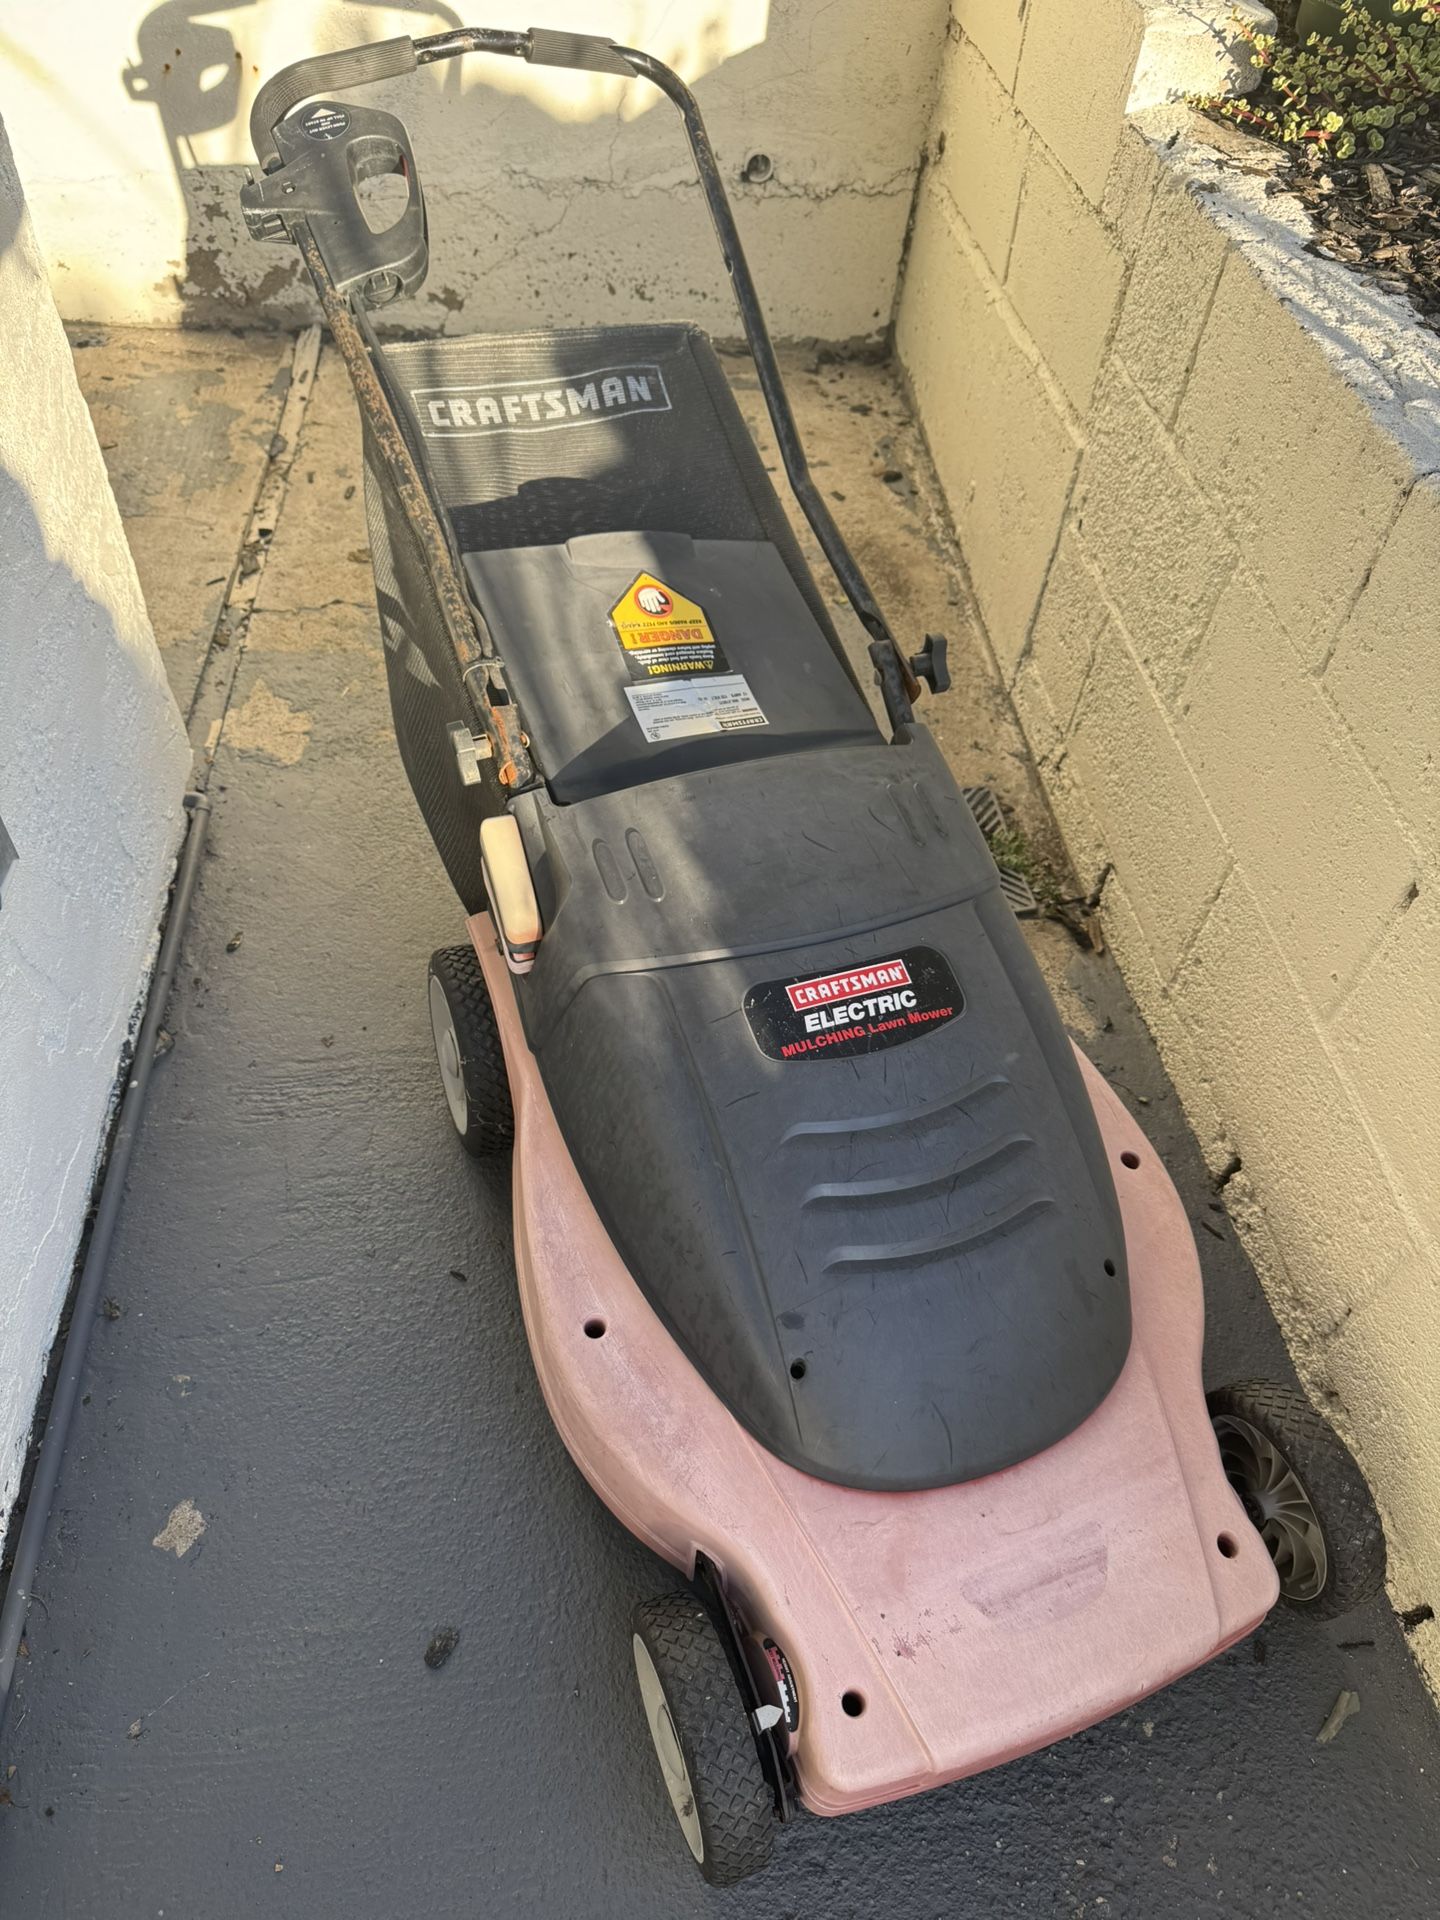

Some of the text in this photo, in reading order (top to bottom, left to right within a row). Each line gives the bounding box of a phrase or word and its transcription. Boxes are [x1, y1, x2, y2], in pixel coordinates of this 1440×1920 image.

[427, 376, 652, 427] CRAFTSMAN
[647, 661, 705, 675] WARNING!
[794, 966, 903, 1004] CRAFTSMAN
[780, 1007, 953, 1057] MULCHING Lawn Mower
[804, 990, 917, 1033] ELECTRIC
